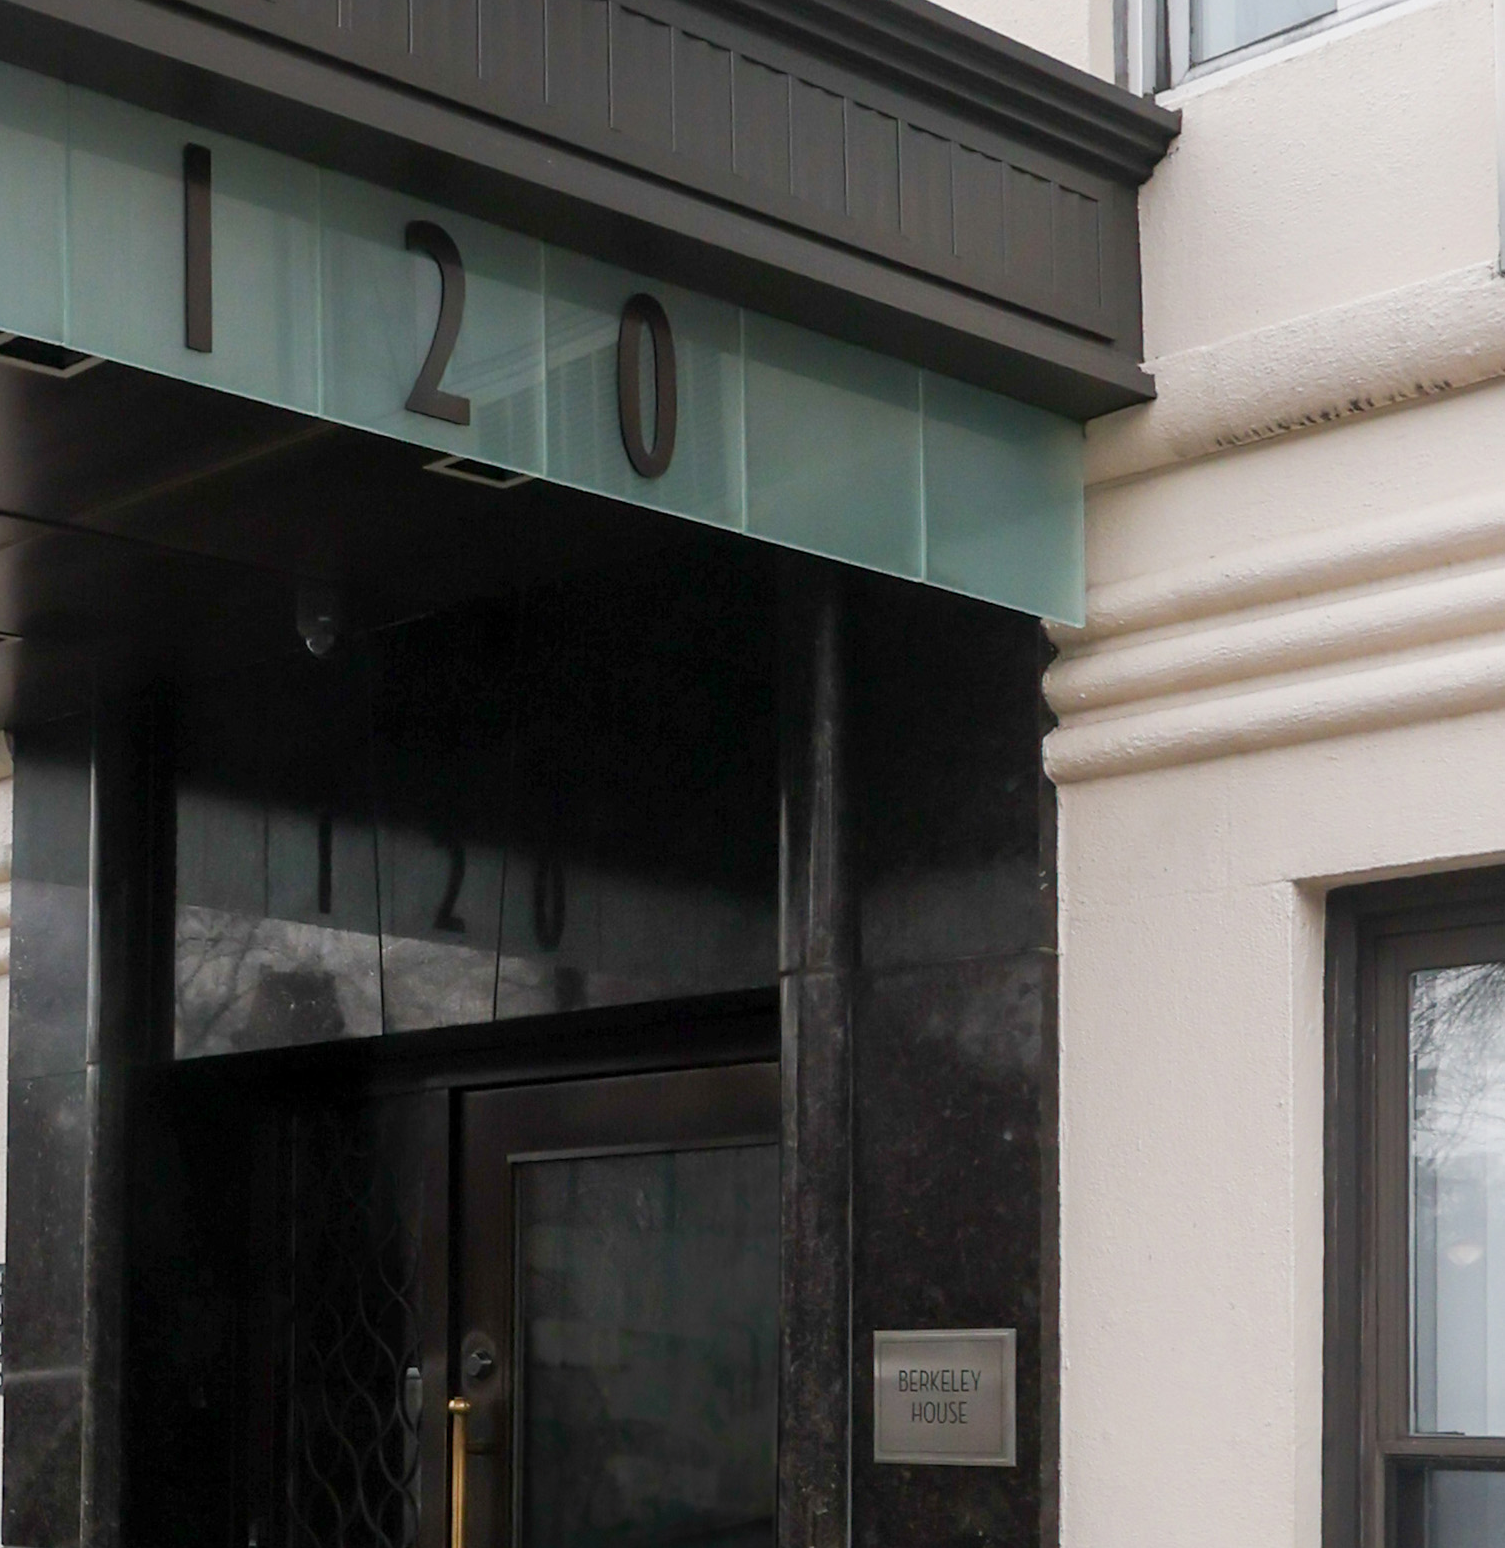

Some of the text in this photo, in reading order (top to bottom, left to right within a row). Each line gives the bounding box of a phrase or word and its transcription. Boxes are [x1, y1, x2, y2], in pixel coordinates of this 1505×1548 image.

[183, 141, 679, 479] 120
[898, 1369, 982, 1393] BERKELEY
[911, 1401, 968, 1424] HOUSE
